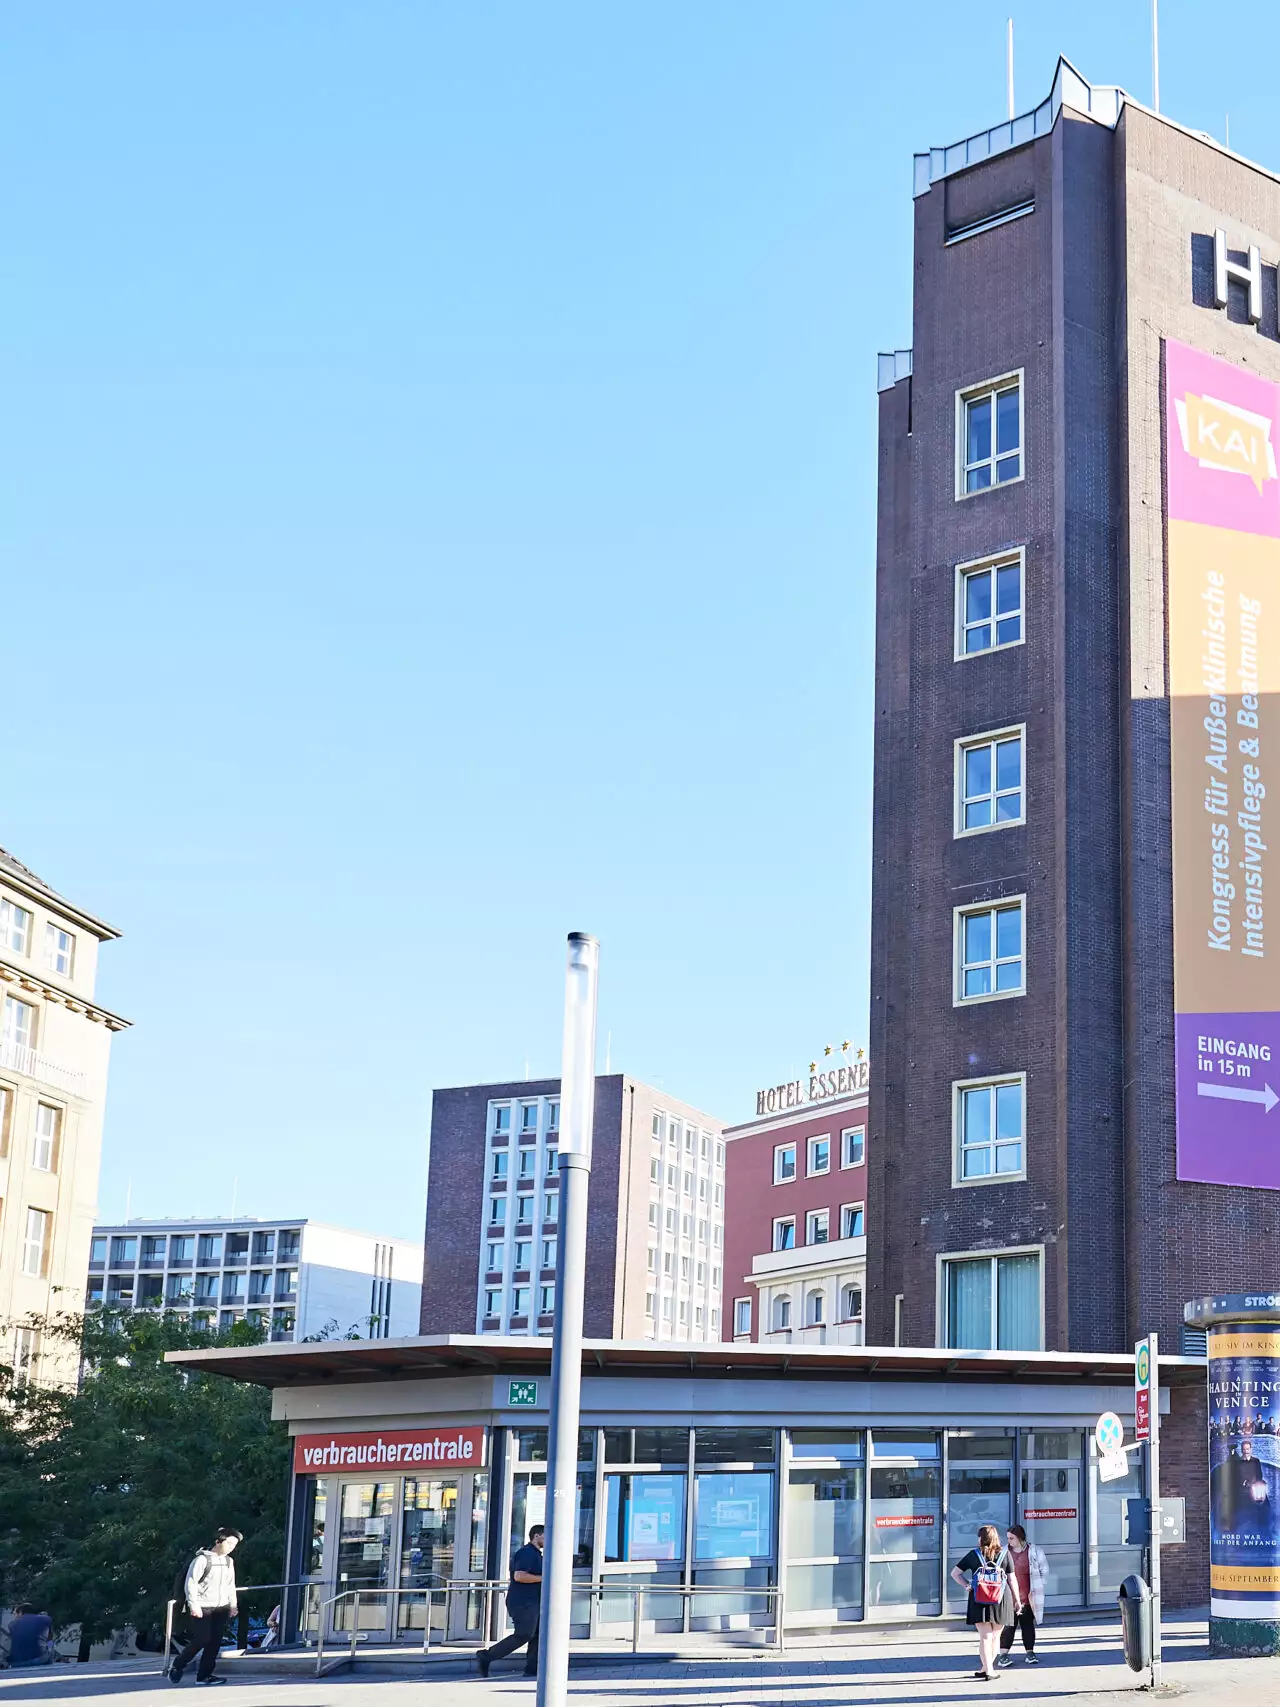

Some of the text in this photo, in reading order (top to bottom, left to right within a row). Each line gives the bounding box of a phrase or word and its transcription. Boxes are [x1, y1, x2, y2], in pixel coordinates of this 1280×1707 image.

[1197, 413, 1258, 467] KAI
[1201, 569, 1236, 952] Kongress für Außerklinische
[1236, 593, 1268, 958] Intensivpflege & Beatmung
[1197, 1035, 1271, 1062] EINGANG
[1197, 1054, 1251, 1078] in 15 m
[755, 1080, 804, 1116] HOTEL
[1242, 1341, 1254, 1349] IM
[1215, 1396, 1270, 1409] VENICE
[303, 1434, 473, 1467] verbraucherzentrale
[876, 1516, 934, 1527] verbraucherzentrale
[1024, 1509, 1077, 1519] verbraucherzentrale
[1228, 1574, 1280, 1583] SEPTEMBER
